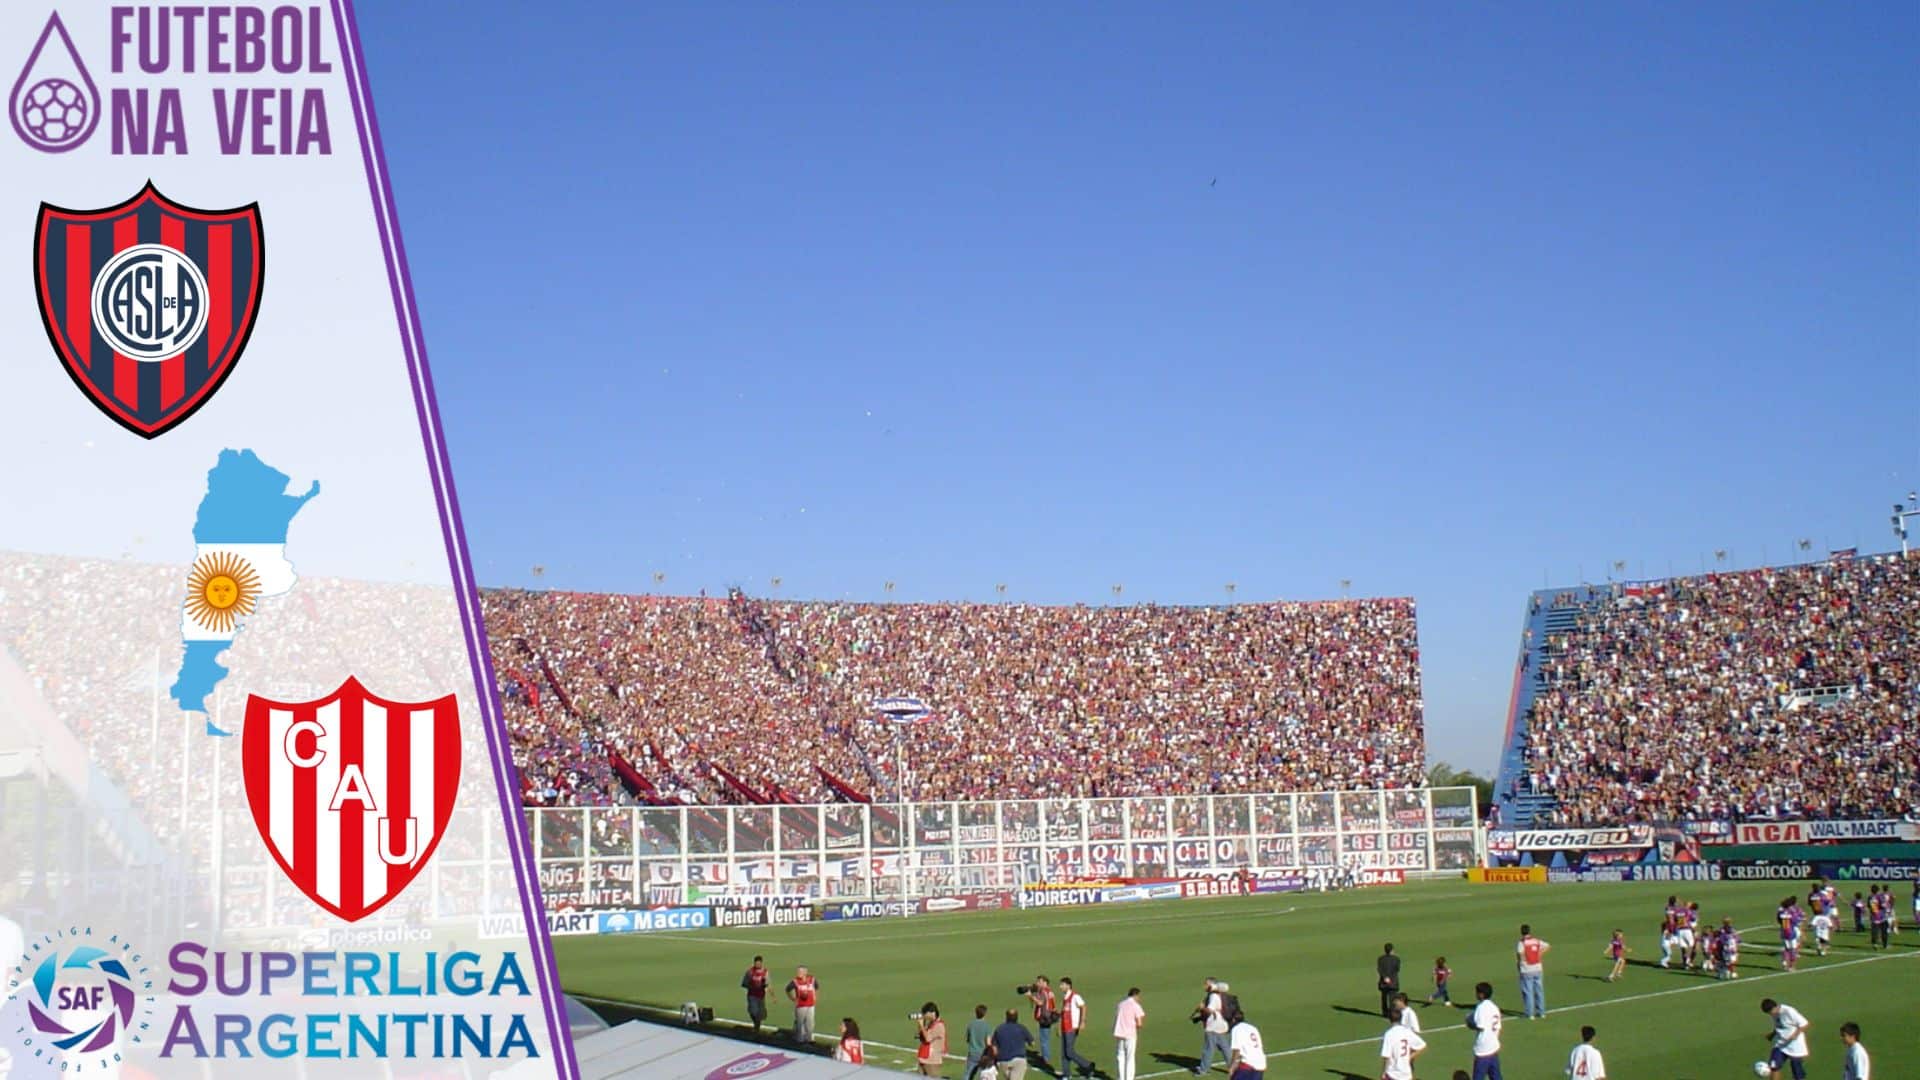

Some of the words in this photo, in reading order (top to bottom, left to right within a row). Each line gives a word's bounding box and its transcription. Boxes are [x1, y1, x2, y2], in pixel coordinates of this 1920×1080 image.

[1591, 831, 1634, 845] BU
[1743, 824, 1800, 842] RCA
[1632, 865, 1721, 880] SAMSUNG
[1727, 864, 1811, 879] CREDICOOP
[1034, 888, 1097, 906] DIRECTV
[715, 906, 762, 927] Venier
[766, 904, 812, 924] Venier
[861, 901, 919, 918] movistar
[634, 911, 705, 930] Macro
[1576, 1058, 1587, 1077] 4
